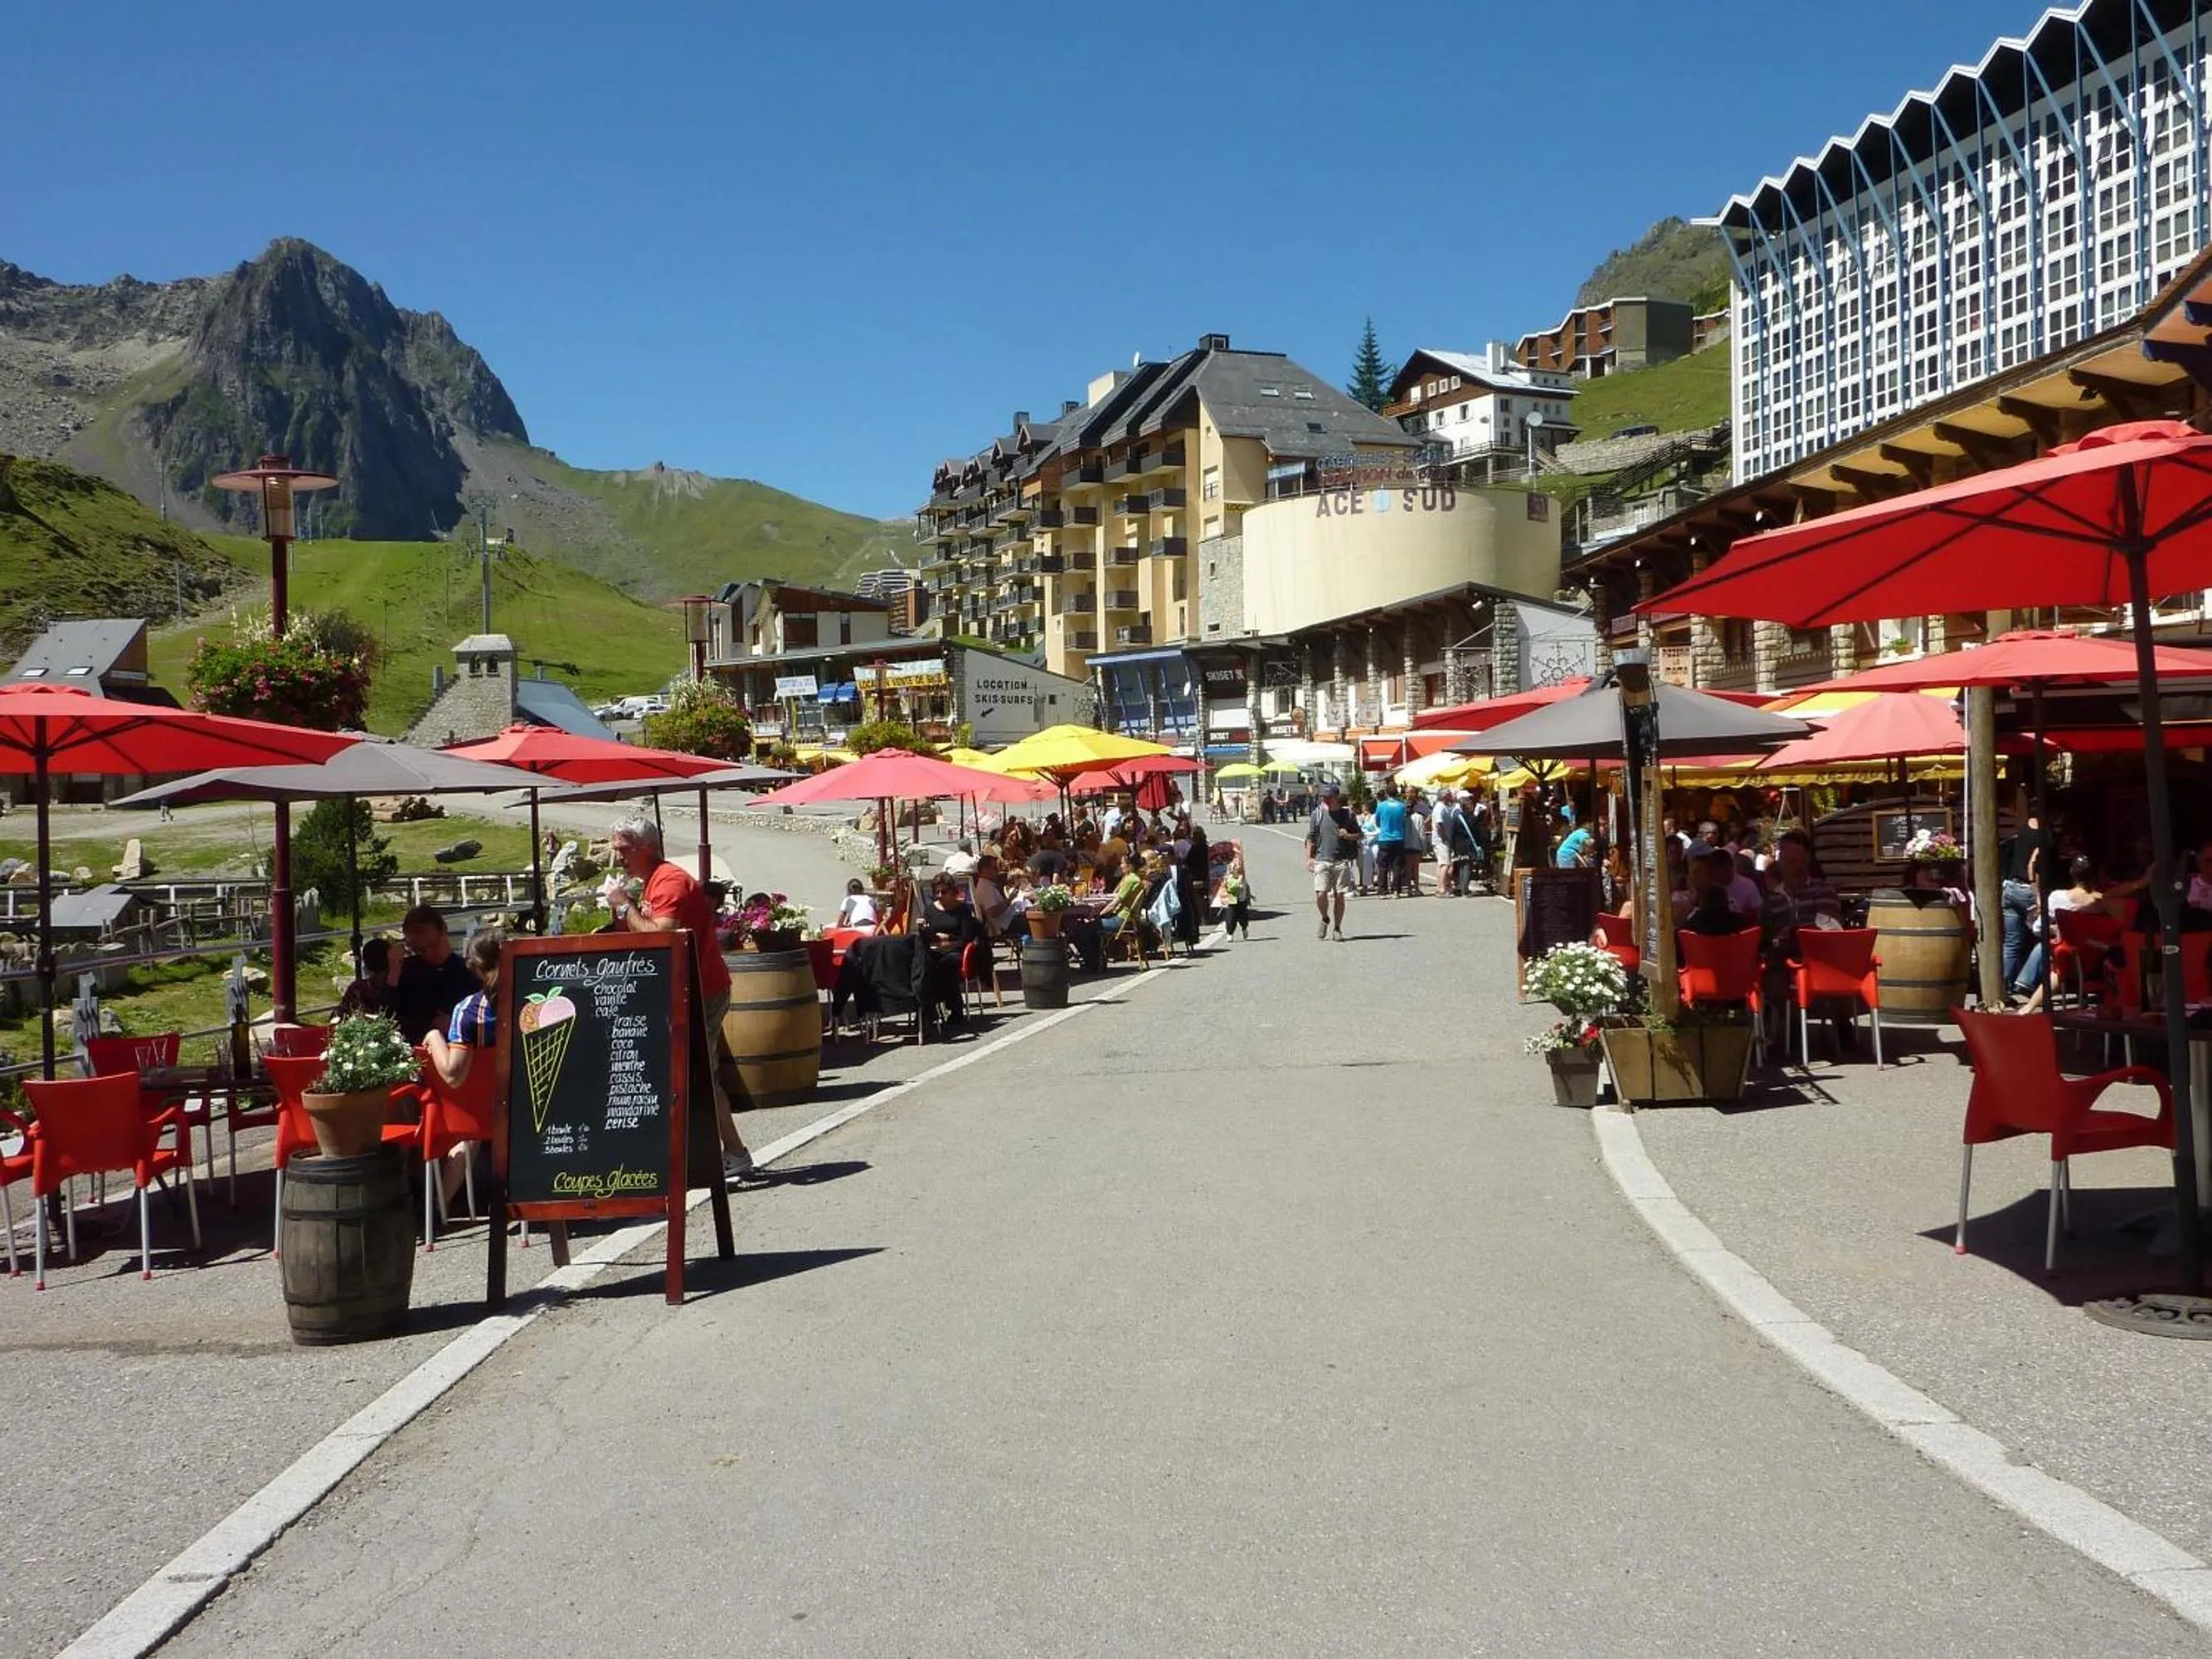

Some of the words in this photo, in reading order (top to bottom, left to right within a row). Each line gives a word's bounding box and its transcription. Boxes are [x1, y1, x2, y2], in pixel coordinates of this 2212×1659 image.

[1316, 489, 1364, 518] ACE
[1403, 487, 1456, 512] SUD
[977, 679, 1028, 690] LOCATION
[536, 957, 589, 979] Cornets
[594, 980, 637, 995] chocolat
[594, 994, 628, 1007] vanille
[611, 1026, 649, 1039] banane
[611, 1039, 634, 1049] coco
[610, 1049, 639, 1062] citron
[610, 1060, 645, 1072] menthe
[608, 1071, 643, 1084] cassis
[608, 1082, 651, 1095] pistache
[605, 1105, 660, 1117] mandarine
[604, 1117, 639, 1130] cerise
[553, 1171, 603, 1196] Coupes
